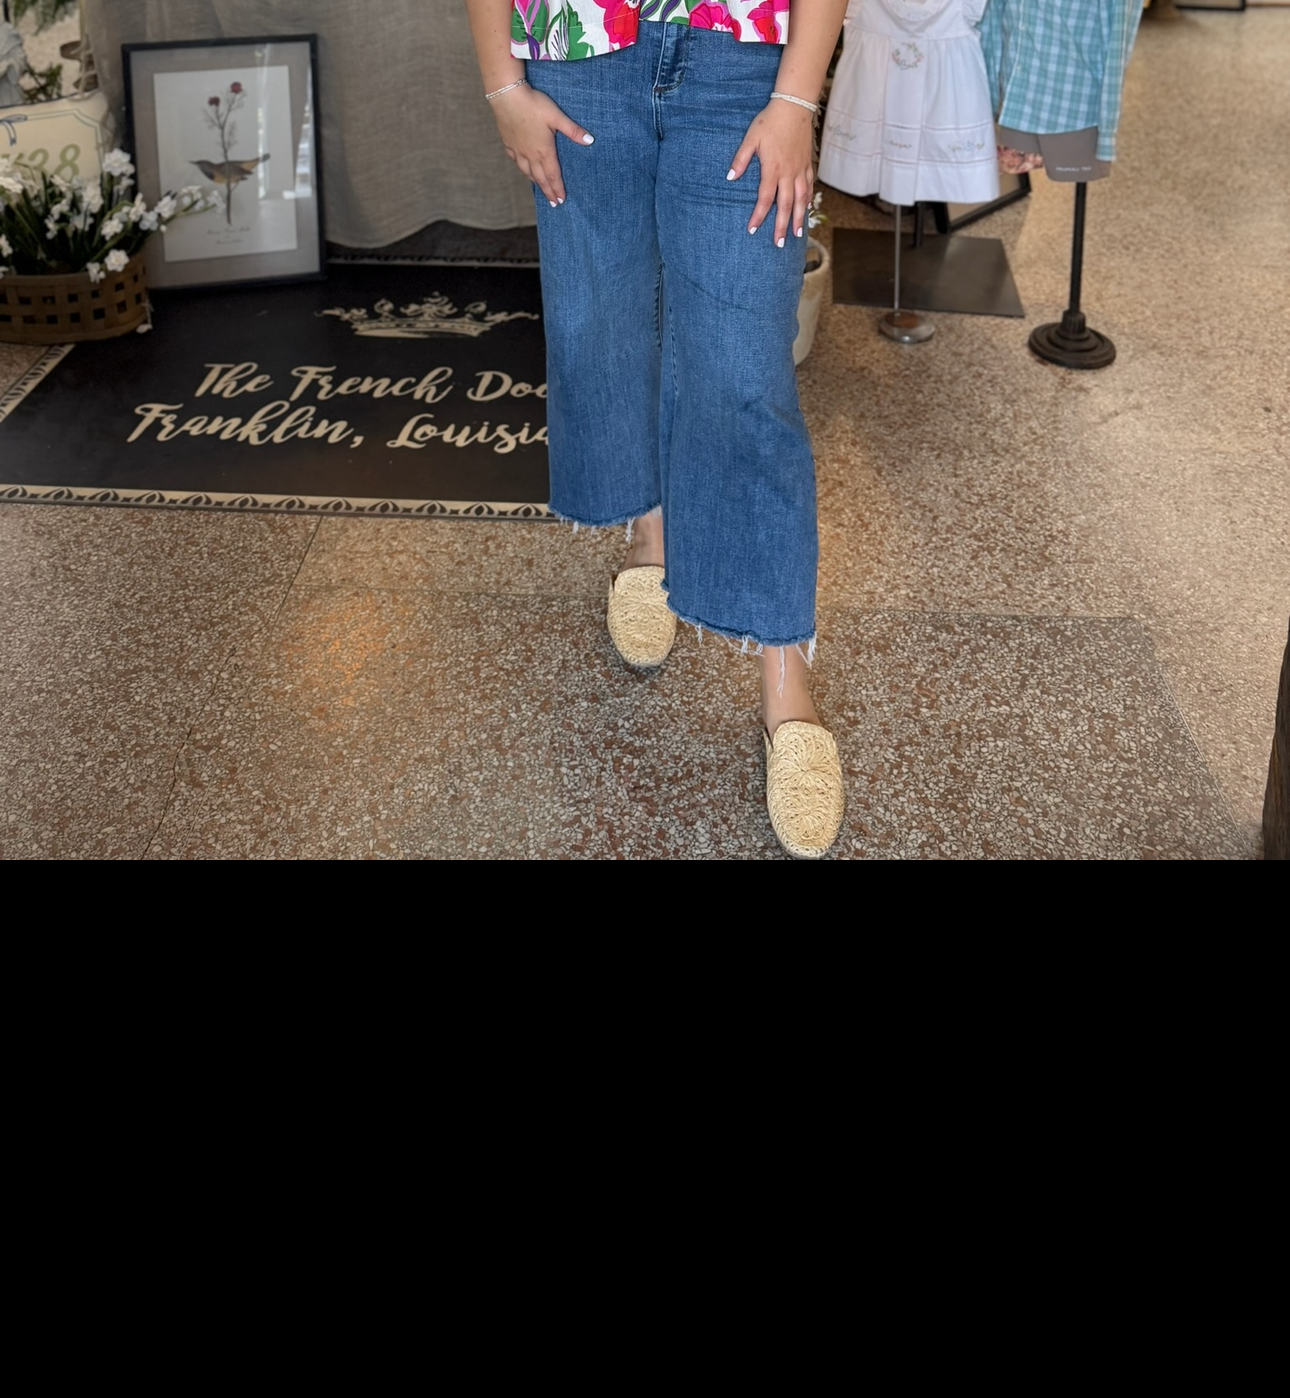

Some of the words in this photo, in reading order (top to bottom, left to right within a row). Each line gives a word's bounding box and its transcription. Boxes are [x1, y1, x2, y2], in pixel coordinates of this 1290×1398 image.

[194, 361, 274, 398] The
[289, 365, 454, 404] French
[466, 370, 548, 401] Doo
[126, 400, 365, 448] Franklin,
[386, 413, 549, 454] Louisia
